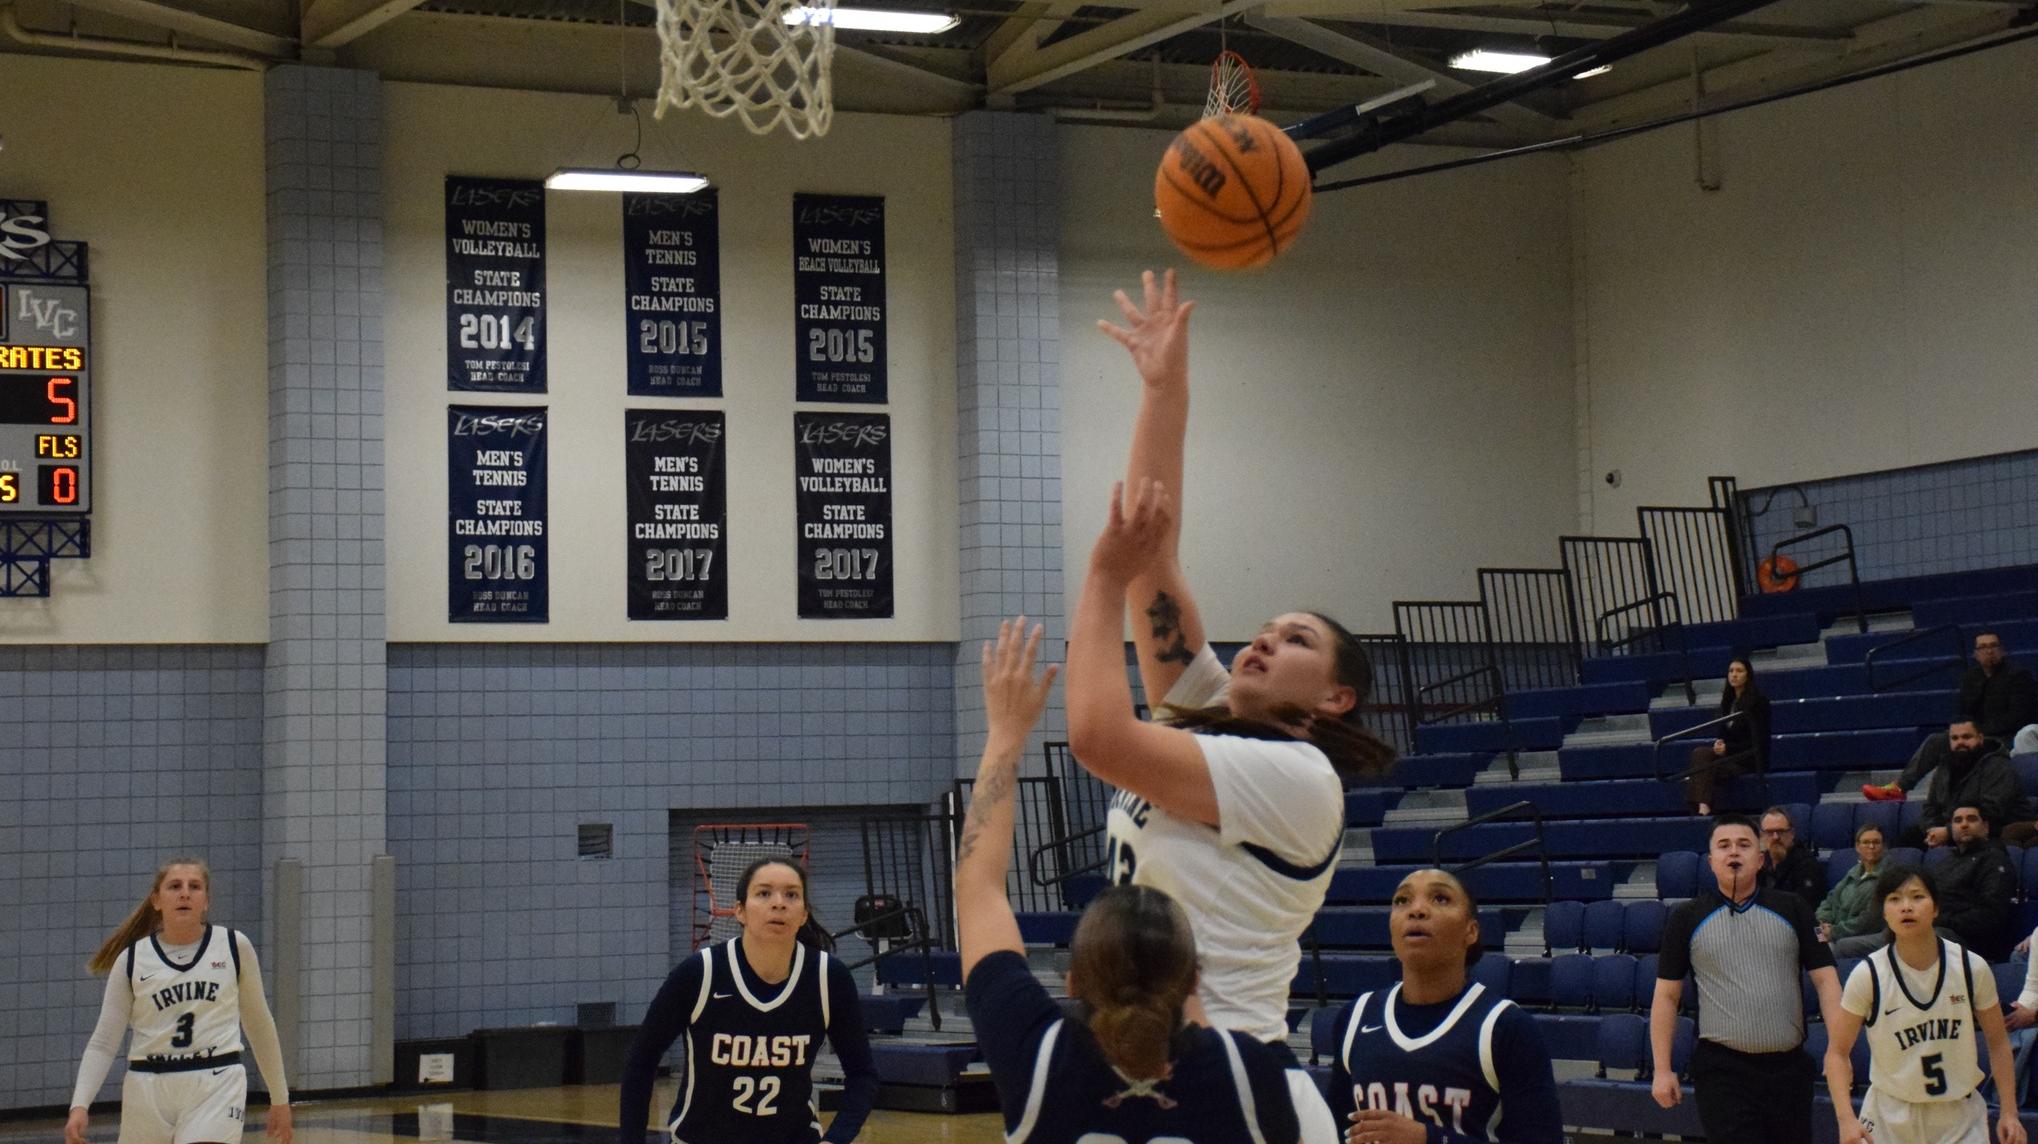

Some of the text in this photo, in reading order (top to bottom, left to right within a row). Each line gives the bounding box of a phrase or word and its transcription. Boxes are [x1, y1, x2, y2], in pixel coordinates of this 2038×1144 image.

[462, 219, 531, 238] WOMEN'S
[648, 230, 693, 246] MEN'S
[808, 238, 871, 255] WOMEN'S
[452, 238, 540, 258] VOLLEYBALL
[645, 249, 696, 265] TENNIS
[799, 257, 880, 274] BEACH VOLLEYBALL
[474, 270, 520, 287] STATE
[651, 277, 695, 293] STATE
[454, 289, 541, 308] CHAMPIONS
[820, 286, 861, 301] STATE
[632, 295, 714, 313] CHAMPIONS
[801, 304, 880, 321] CHAMPIONS
[18, 289, 77, 339] IVC
[460, 313, 535, 350] 2014
[640, 319, 708, 355] 2015
[809, 328, 874, 363] 2015
[470, 372, 524, 382] HEAD COACH
[48, 378, 75, 423] 5
[453, 415, 543, 439] LASERS
[630, 420, 721, 446] LASERS
[800, 422, 887, 448] LASERS
[39, 436, 78, 458] FLS
[476, 450, 523, 466] MEN'S
[654, 456, 698, 472] MEN'S
[811, 458, 875, 474] WOMEN'S
[53, 468, 75, 503] 0
[473, 470, 527, 486] TENNIS
[649, 475, 704, 491] TENNIS
[800, 477, 887, 493] VOLLEYBALL
[477, 500, 522, 516] STATE
[655, 505, 699, 520] STATE
[823, 505, 865, 520] STATE
[456, 520, 542, 536] CHAMPIONS
[635, 523, 719, 539] CHAMPIONS
[804, 523, 884, 539] CHAMPIONS
[464, 544, 535, 580] 2016
[646, 549, 713, 580] 2017
[815, 548, 879, 580] 2017
[152, 981, 219, 1011] IRVINE
[171, 1012, 195, 1048] 3
[1894, 1018, 1962, 1051] IRVINE
[711, 1033, 811, 1066] COAST
[1921, 1052, 1948, 1096] 5
[732, 1076, 781, 1116] 22
